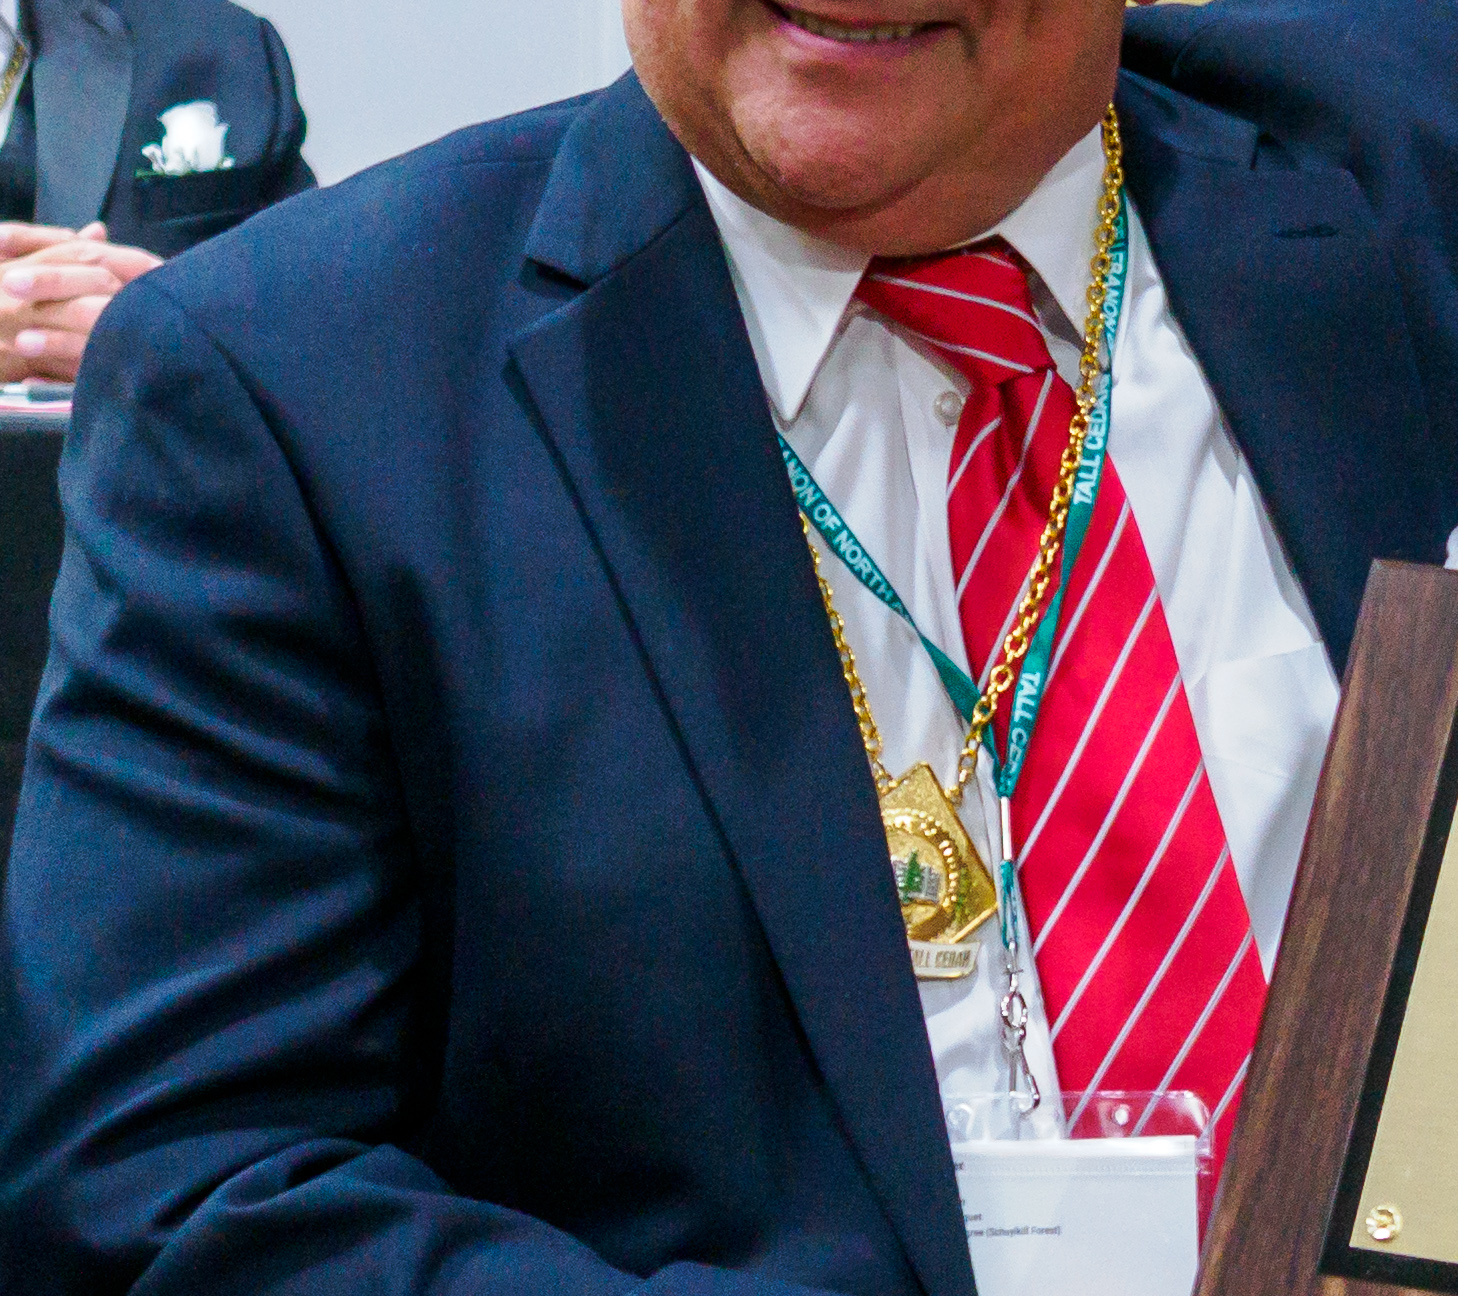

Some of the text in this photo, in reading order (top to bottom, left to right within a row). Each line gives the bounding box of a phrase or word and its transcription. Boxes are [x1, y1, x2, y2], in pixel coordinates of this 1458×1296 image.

[1073, 454, 1102, 505] TALL
[812, 503, 842, 531] OF
[832, 528, 894, 601] NORTH
[1013, 671, 1041, 723] TALL
